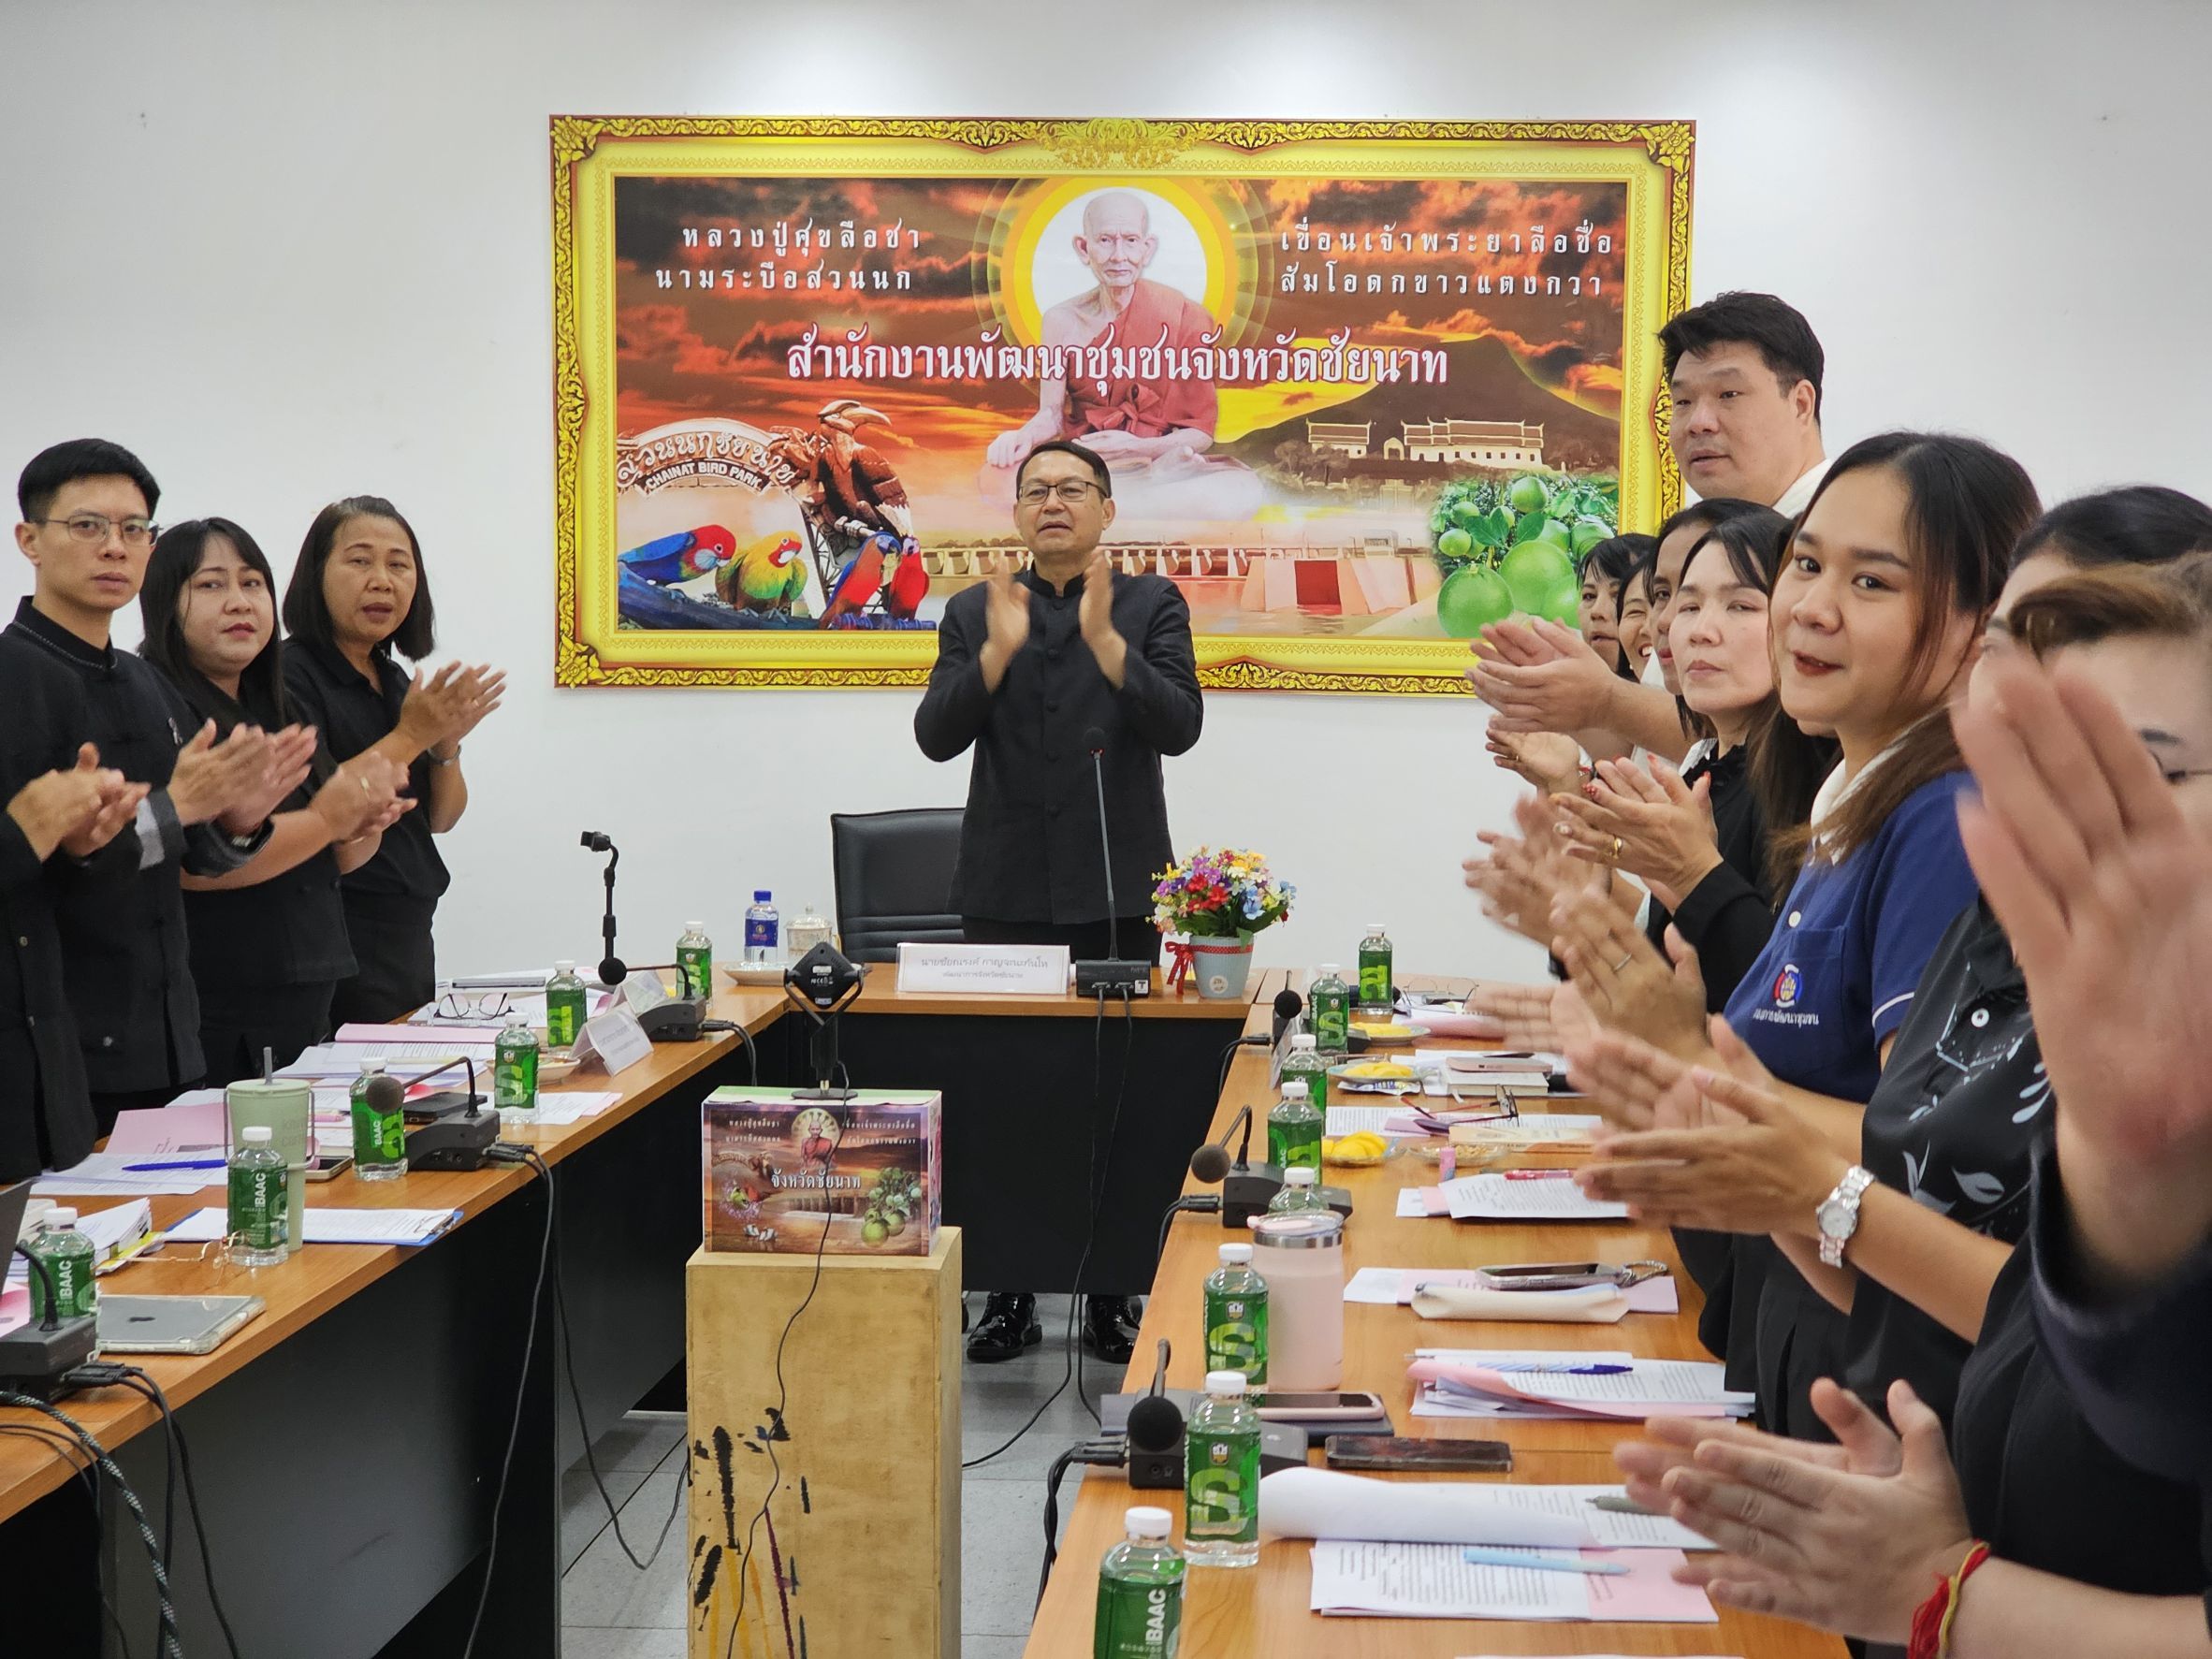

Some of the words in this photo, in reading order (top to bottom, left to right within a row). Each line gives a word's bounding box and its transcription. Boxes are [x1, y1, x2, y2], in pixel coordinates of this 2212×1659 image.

[682, 216, 920, 257] หลวงปู่ศุขลือชา
[1280, 216, 1612, 255] เขื่อนเจ้าพระยาลือชื่อ
[656, 257, 911, 290] นามระบือสวนนก
[787, 321, 1448, 398] สำนักงานพัฒนาชุมชนจังหวัดชัยนาท
[646, 462, 696, 489] CHAINAT
[697, 461, 724, 475] BIRD
[729, 468, 763, 489] PARK
[255, 1172, 267, 1205] BAAC
[771, 1169, 861, 1189] จังหวัดชัยนาท
[59, 1259, 73, 1296] BAAC
[1145, 1588, 1166, 1641] BAAC
